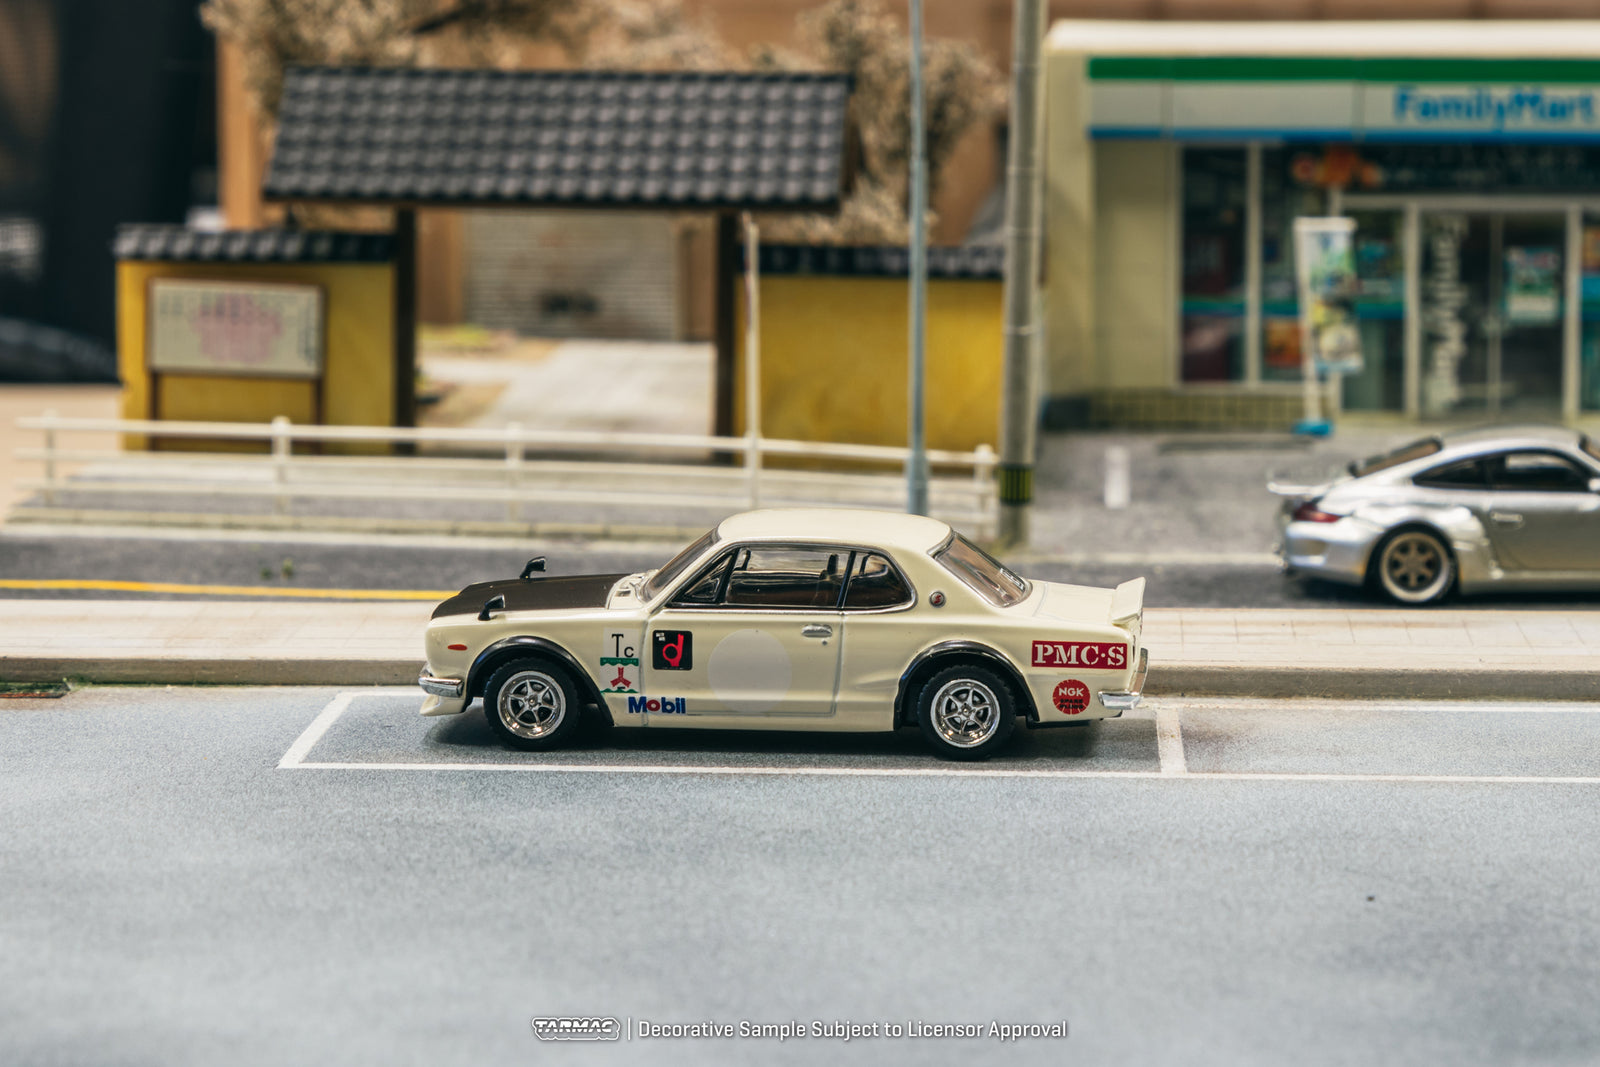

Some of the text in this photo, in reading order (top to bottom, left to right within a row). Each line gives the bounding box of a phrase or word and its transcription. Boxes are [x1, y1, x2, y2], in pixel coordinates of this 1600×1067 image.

[1395, 85, 1595, 131] FamilyMart
[1058, 687, 1085, 697] NGK
[628, 696, 686, 714] Mobil
